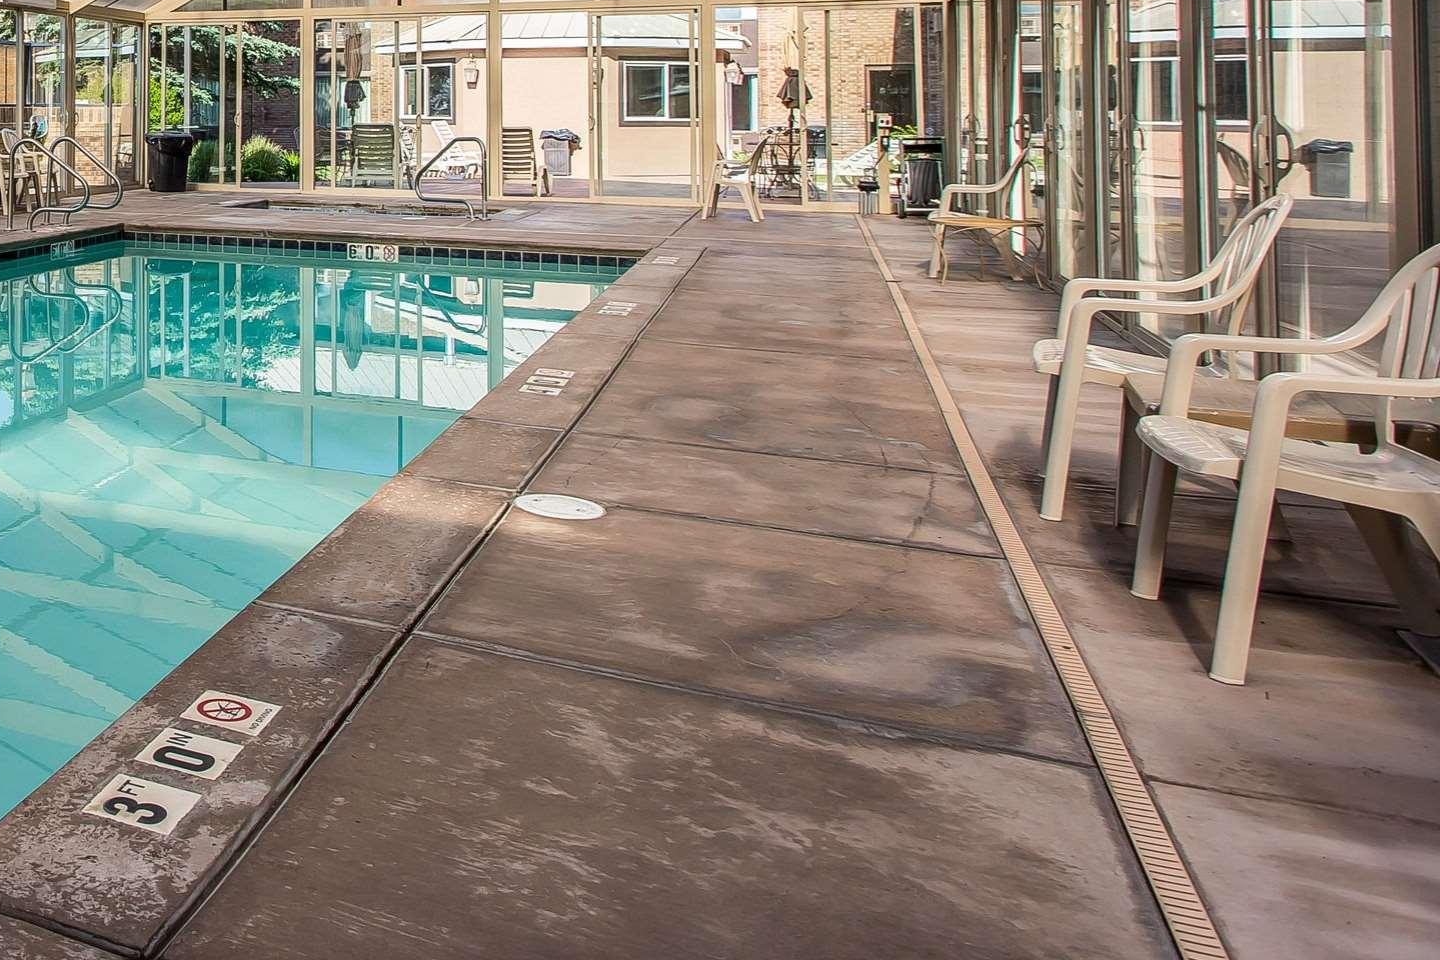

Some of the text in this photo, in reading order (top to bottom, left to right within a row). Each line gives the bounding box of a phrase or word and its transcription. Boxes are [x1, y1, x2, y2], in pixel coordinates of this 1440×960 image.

[102, 732, 216, 825] 3 FT 0 IN
